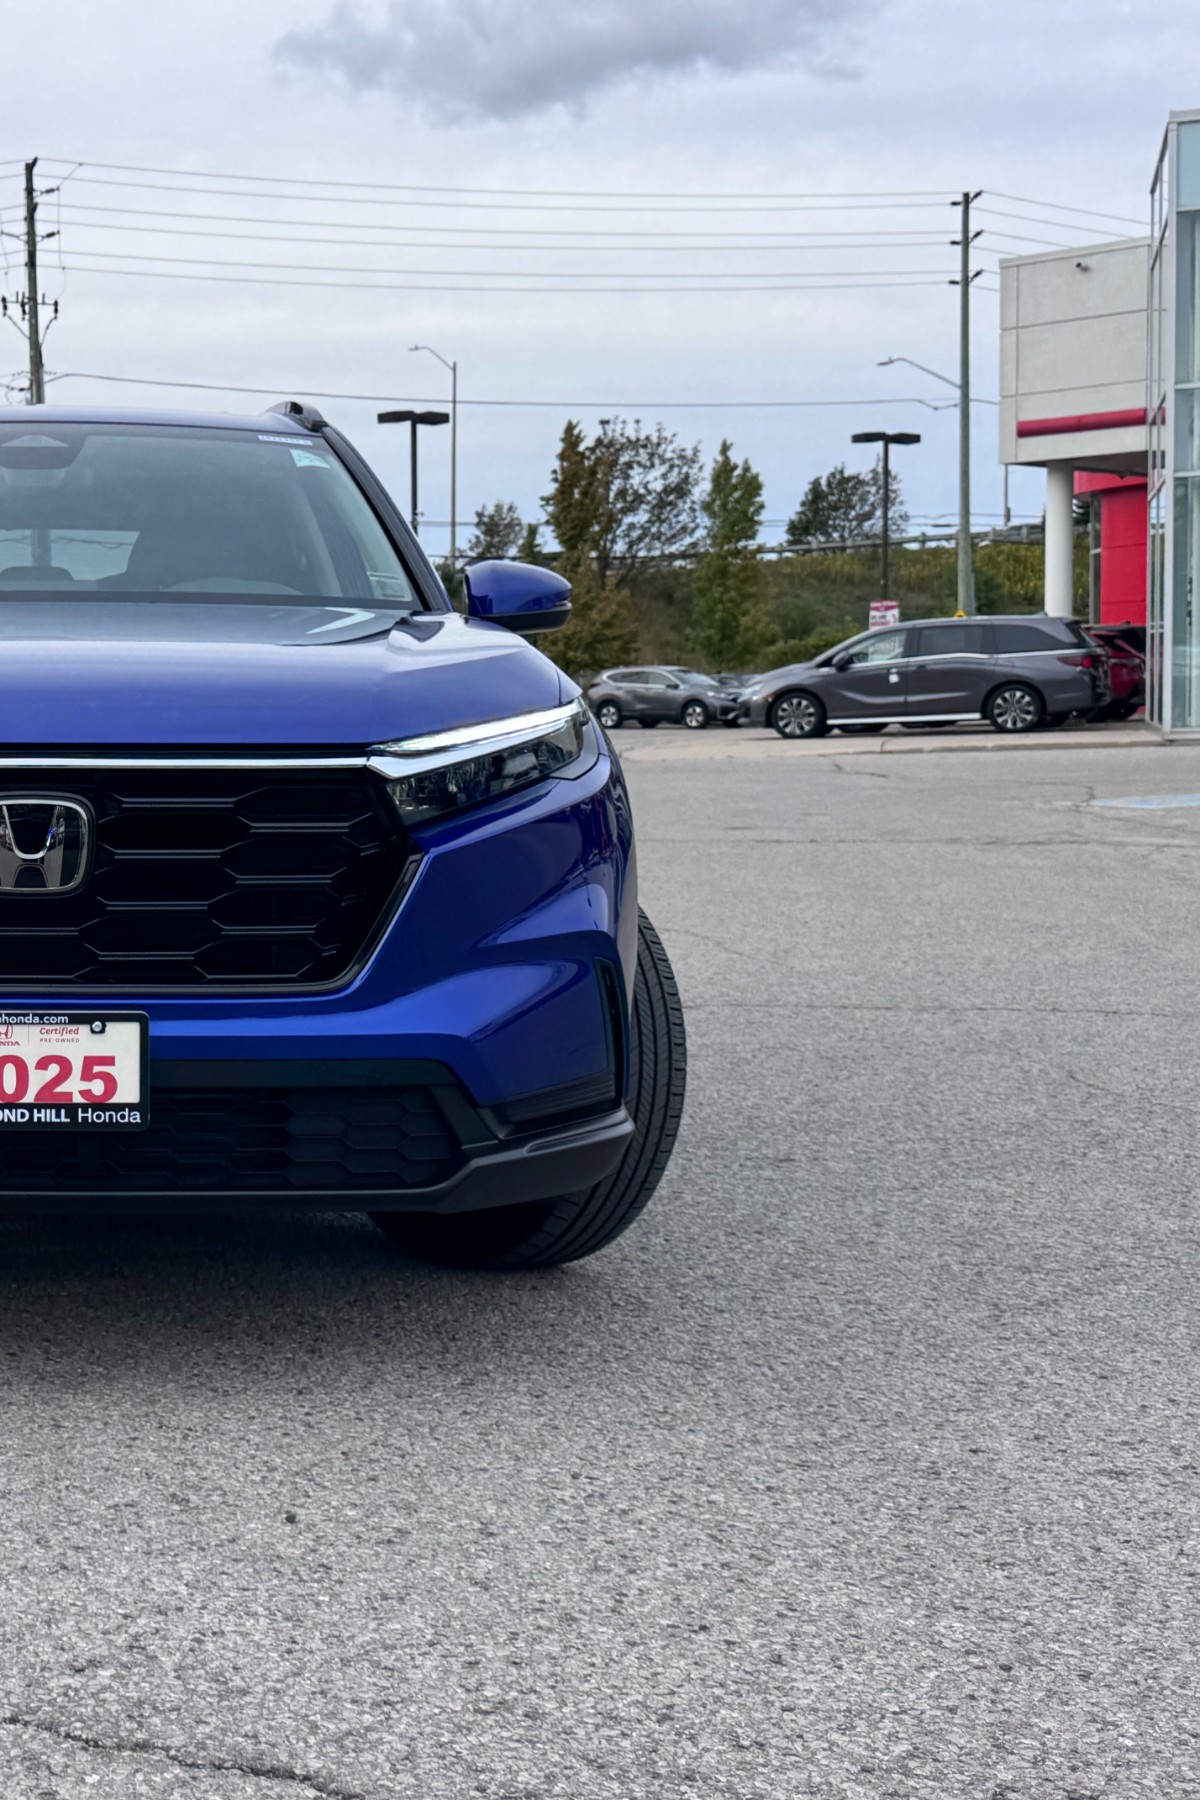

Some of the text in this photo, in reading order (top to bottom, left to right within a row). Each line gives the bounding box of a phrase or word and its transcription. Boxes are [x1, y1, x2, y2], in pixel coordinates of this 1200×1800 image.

[39, 1027, 80, 1036] Certified
[33, 1108, 71, 1123] HILL
[78, 1107, 141, 1123] Honda
